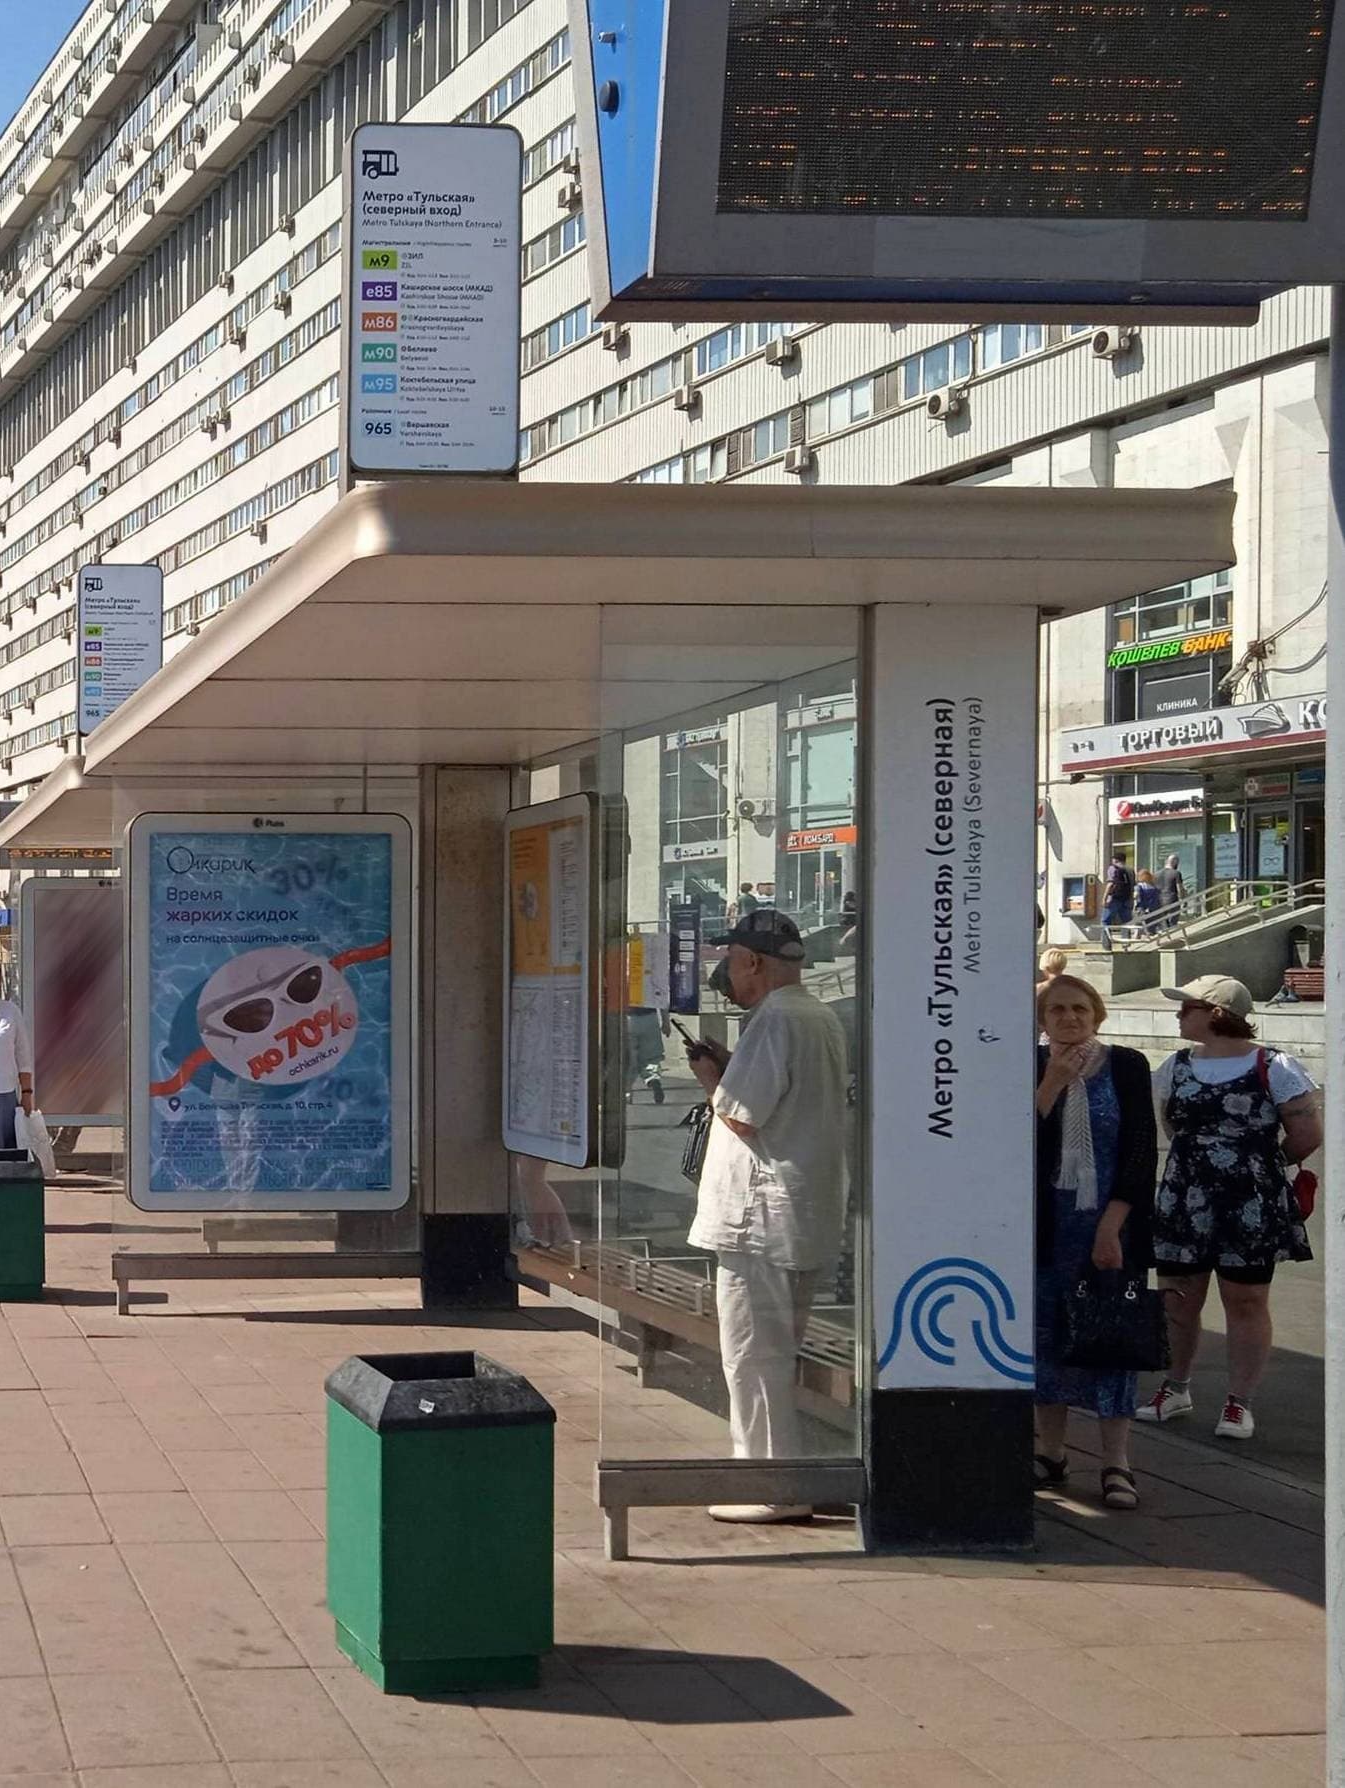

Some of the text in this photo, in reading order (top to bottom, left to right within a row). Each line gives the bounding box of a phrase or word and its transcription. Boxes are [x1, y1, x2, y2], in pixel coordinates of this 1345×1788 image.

[363, 191, 475, 204] Метро «Тульская»
[362, 204, 462, 216] (северный вход)
[364, 422, 392, 435] 965
[1182, 630, 1231, 654] БАНК
[1156, 697, 1198, 713] КЛИНИКА
[1118, 716, 1221, 748] ТОРГОВЫЙ
[964, 697, 986, 974] Metro Tulskaya (Severnaya)
[166, 887, 223, 905] Время
[166, 910, 299, 925] жарких скидок
[926, 698, 959, 1139] Метро «Тульская» (северная)
[182, 935, 290, 944] солнцезащитные
[274, 1002, 356, 1059] 70%
[288, 1046, 340, 1077] ochkarik.ru
